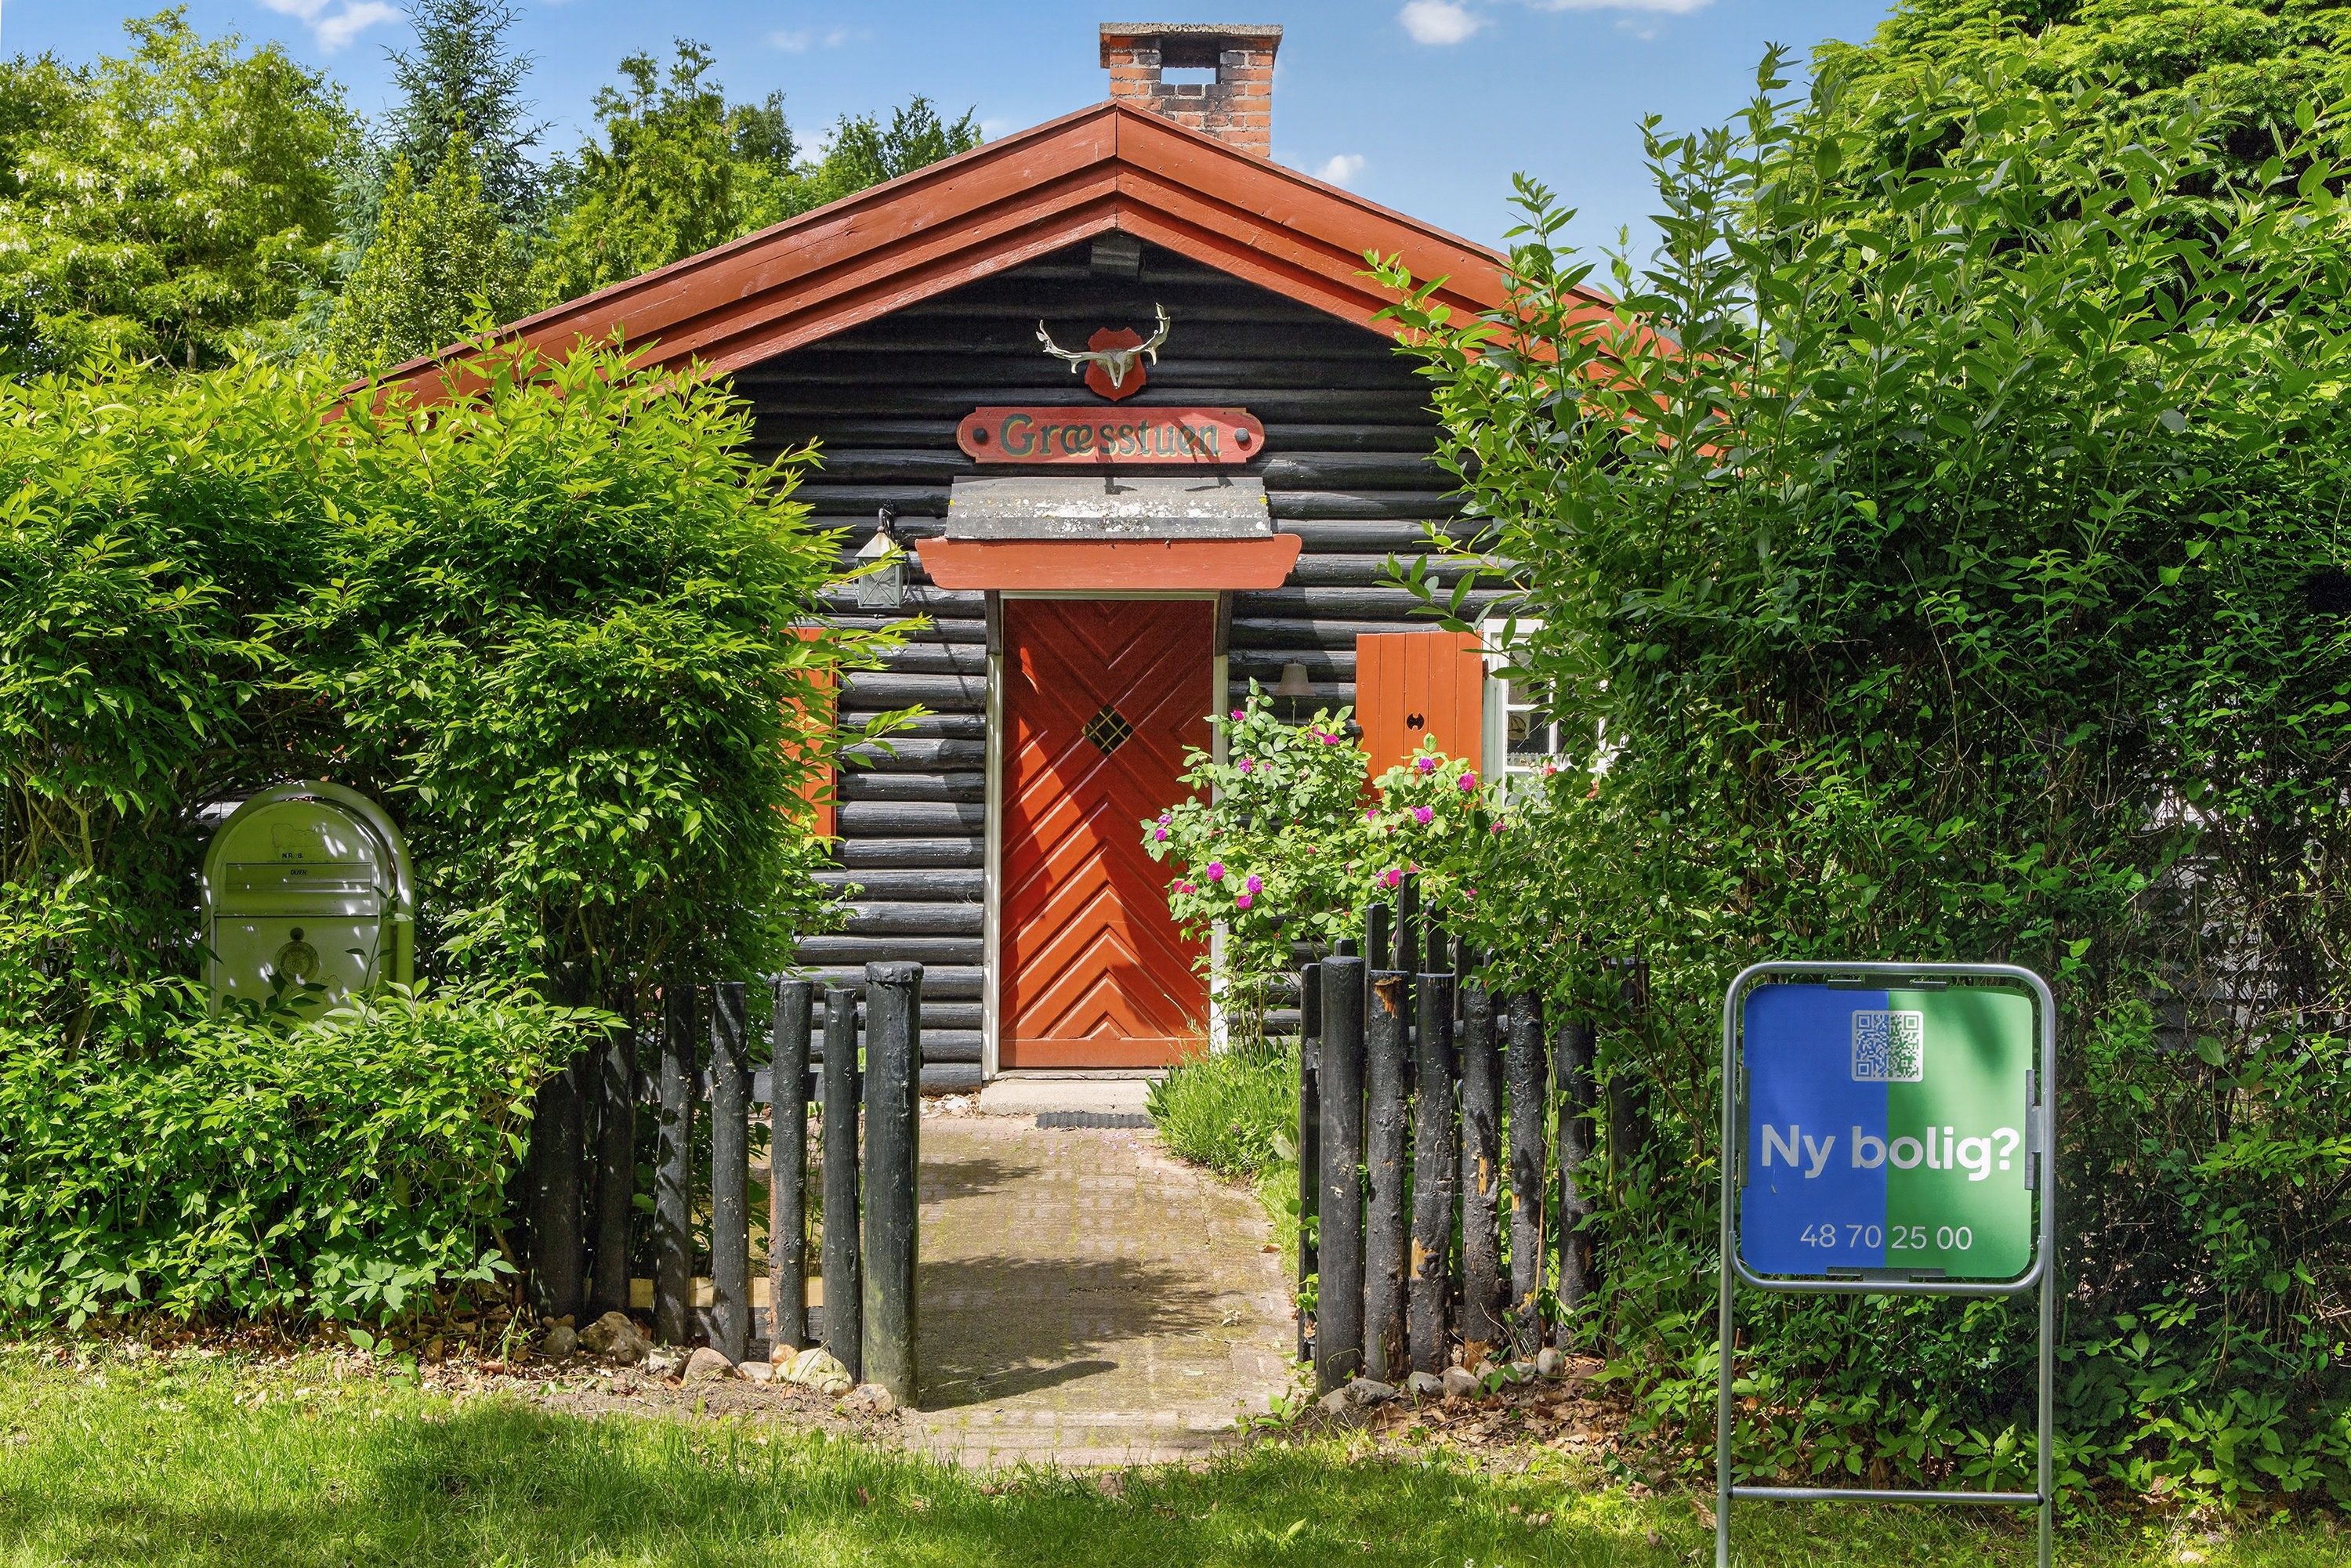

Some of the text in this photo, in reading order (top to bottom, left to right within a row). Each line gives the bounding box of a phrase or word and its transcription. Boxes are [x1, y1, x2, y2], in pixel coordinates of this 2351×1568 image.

[1000, 413, 1222, 456] Græsstuen
[1761, 1124, 2020, 1182] Ny bolig?
[1800, 1223, 1973, 1250] 48 70 25 00
